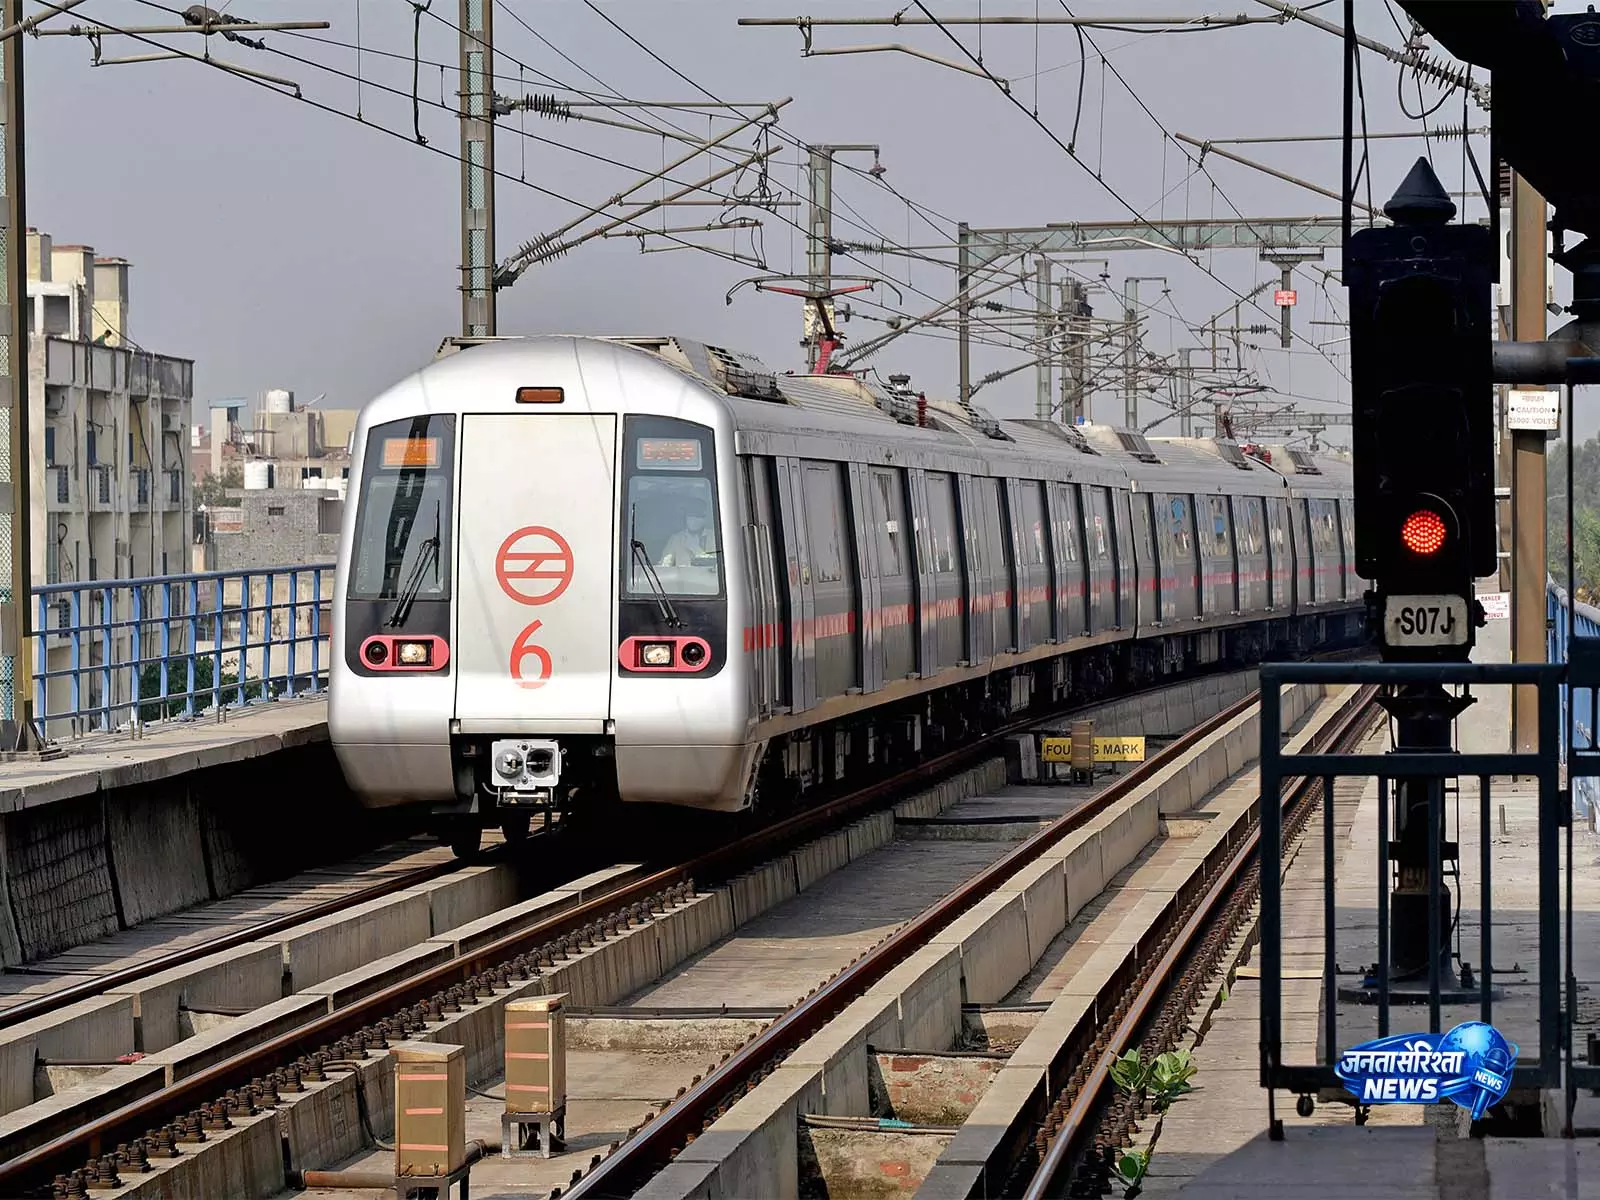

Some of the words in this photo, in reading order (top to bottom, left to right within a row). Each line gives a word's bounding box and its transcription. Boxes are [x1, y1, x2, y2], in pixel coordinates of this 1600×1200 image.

[1516, 406, 1551, 414] CAUTION
[1532, 417, 1558, 425] VOLTS
[1400, 607, 1452, 635] S07J
[510, 619, 553, 689] 6
[1046, 744, 1099, 755] FOUG
[1103, 743, 1139, 754] MARK
